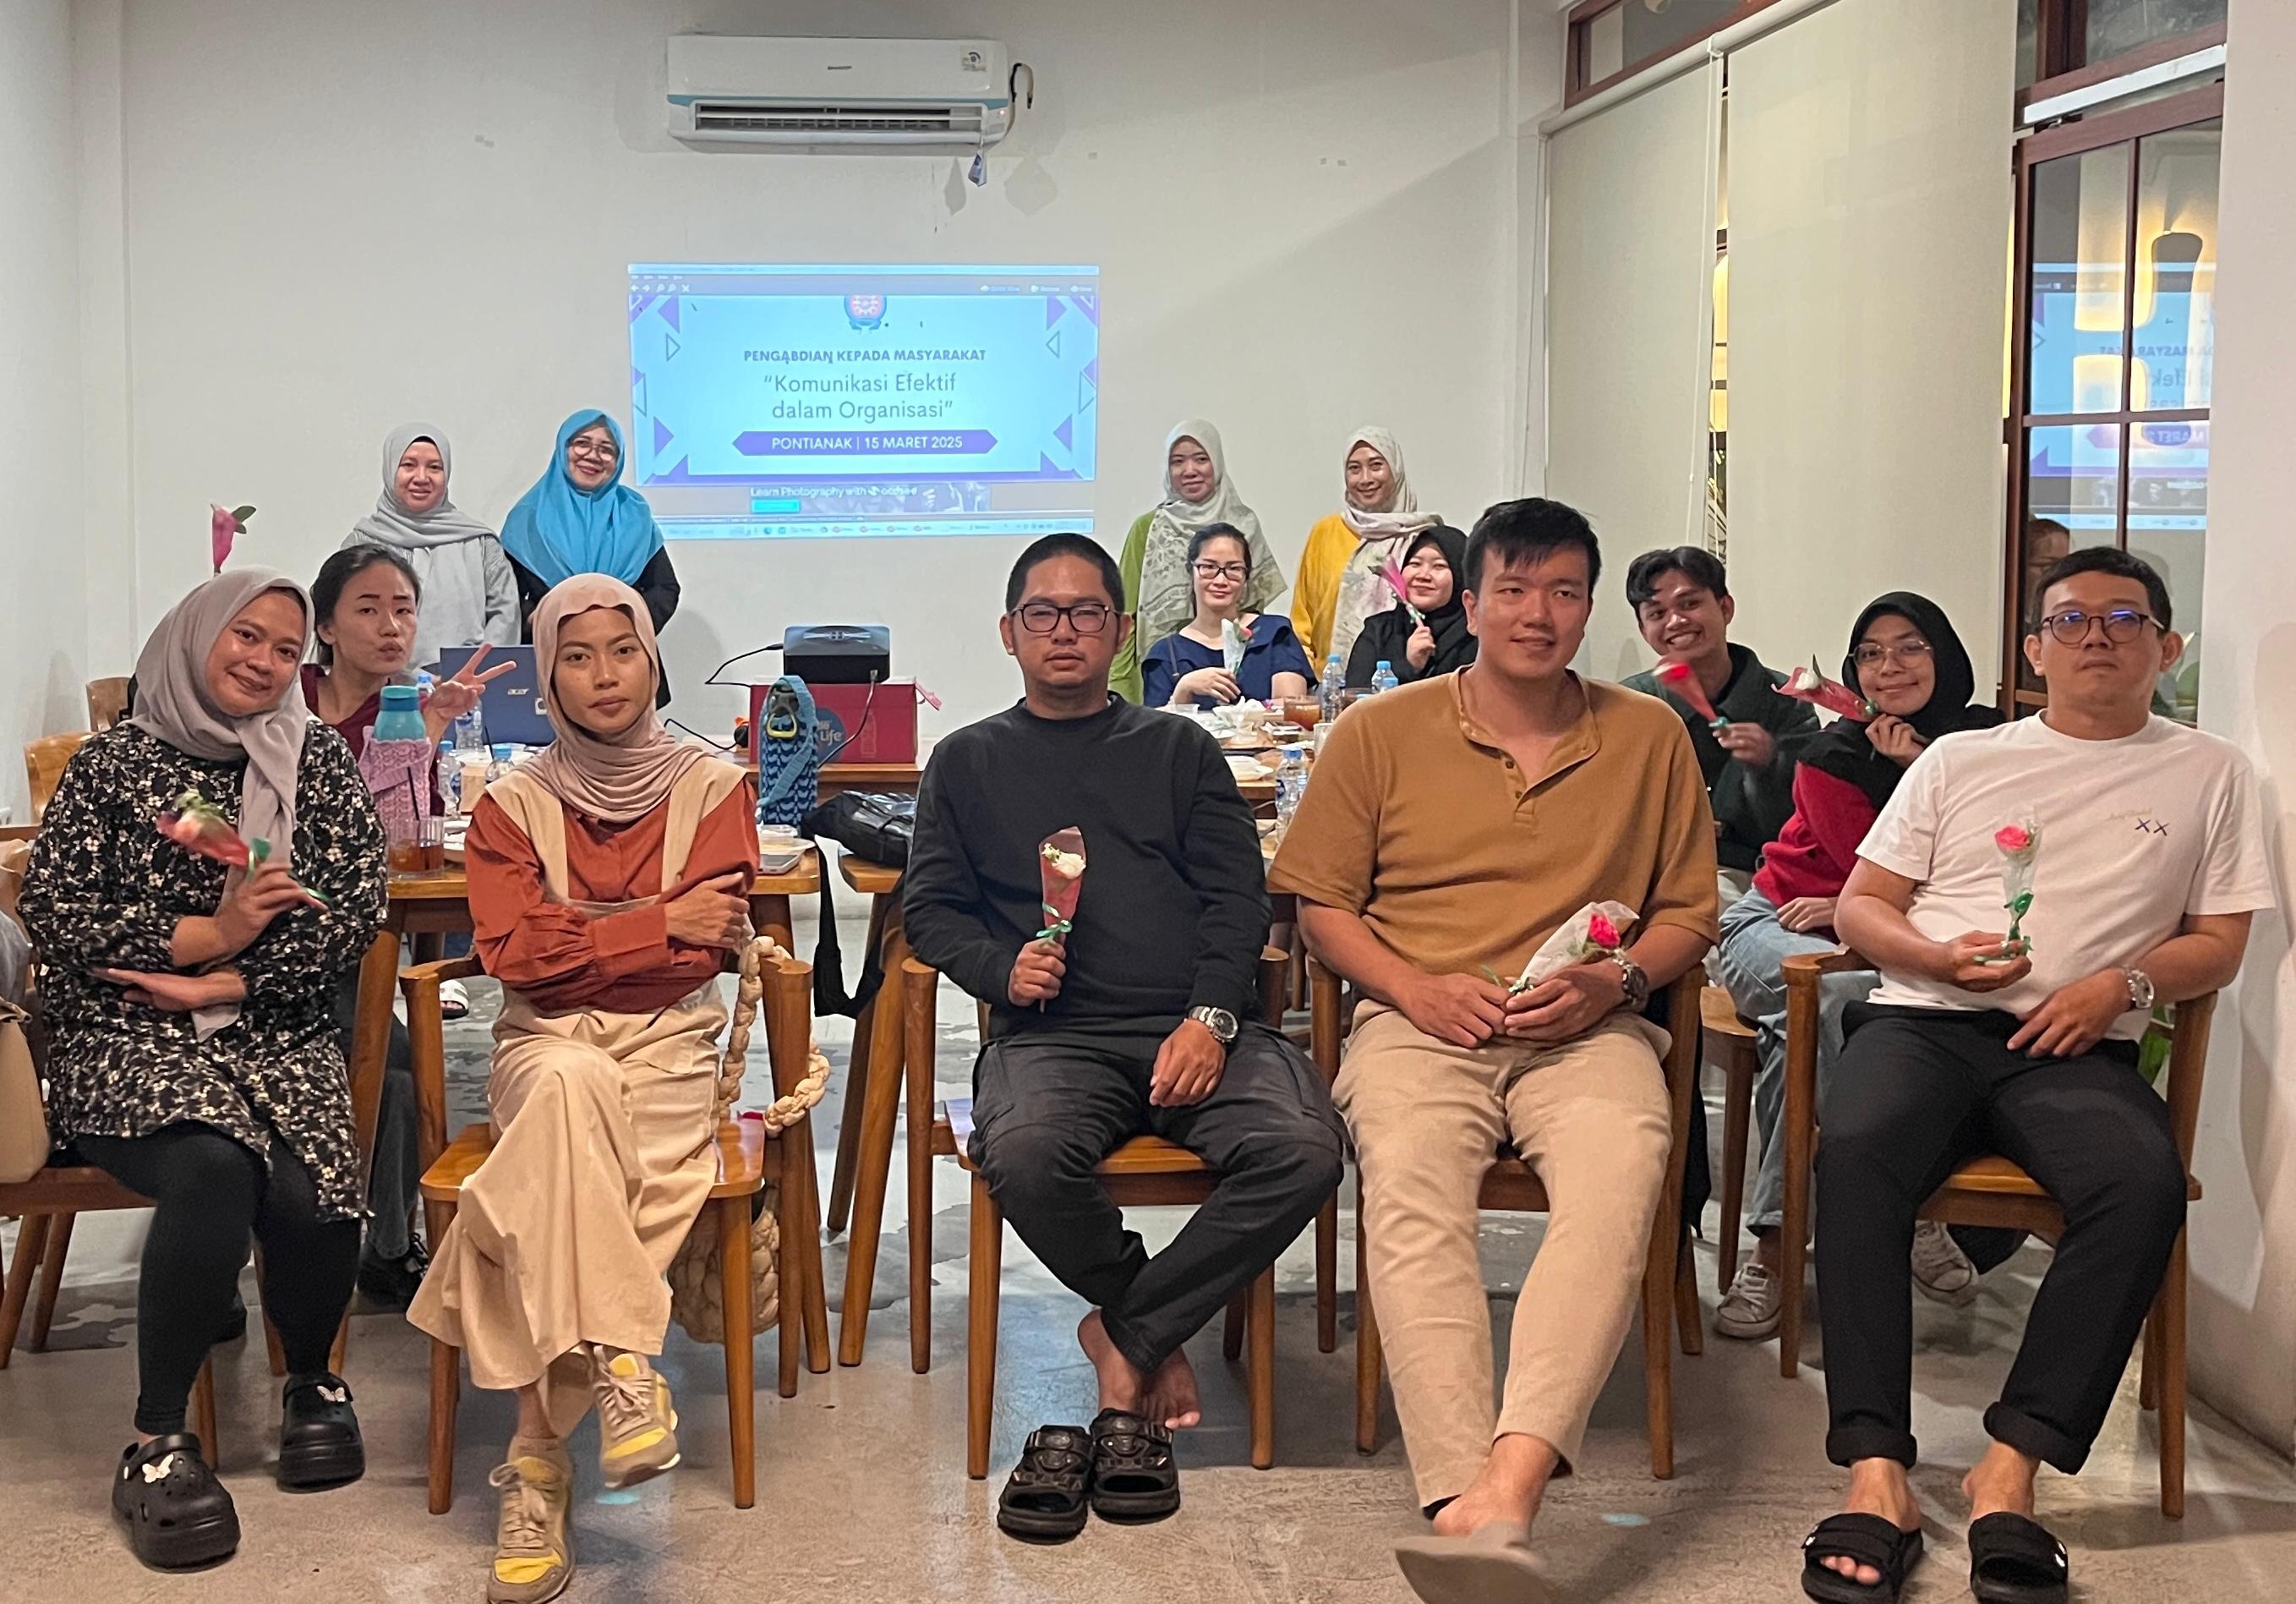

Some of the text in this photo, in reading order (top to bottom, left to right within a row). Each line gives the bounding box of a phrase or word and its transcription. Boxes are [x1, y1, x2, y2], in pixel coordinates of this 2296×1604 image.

[743, 349, 987, 362] PENGABDIAN KEPADA MASYARAKAT
[895, 372, 957, 391] Efektif
[772, 400, 833, 419] dalam
[772, 437, 852, 450] PONTIANAK
[865, 437, 879, 449] 15
[883, 436, 928, 449] MARET
[931, 436, 963, 448] 2025
[750, 486, 781, 496] Learn
[781, 486, 845, 498] Photography
[845, 485, 867, 496] with
